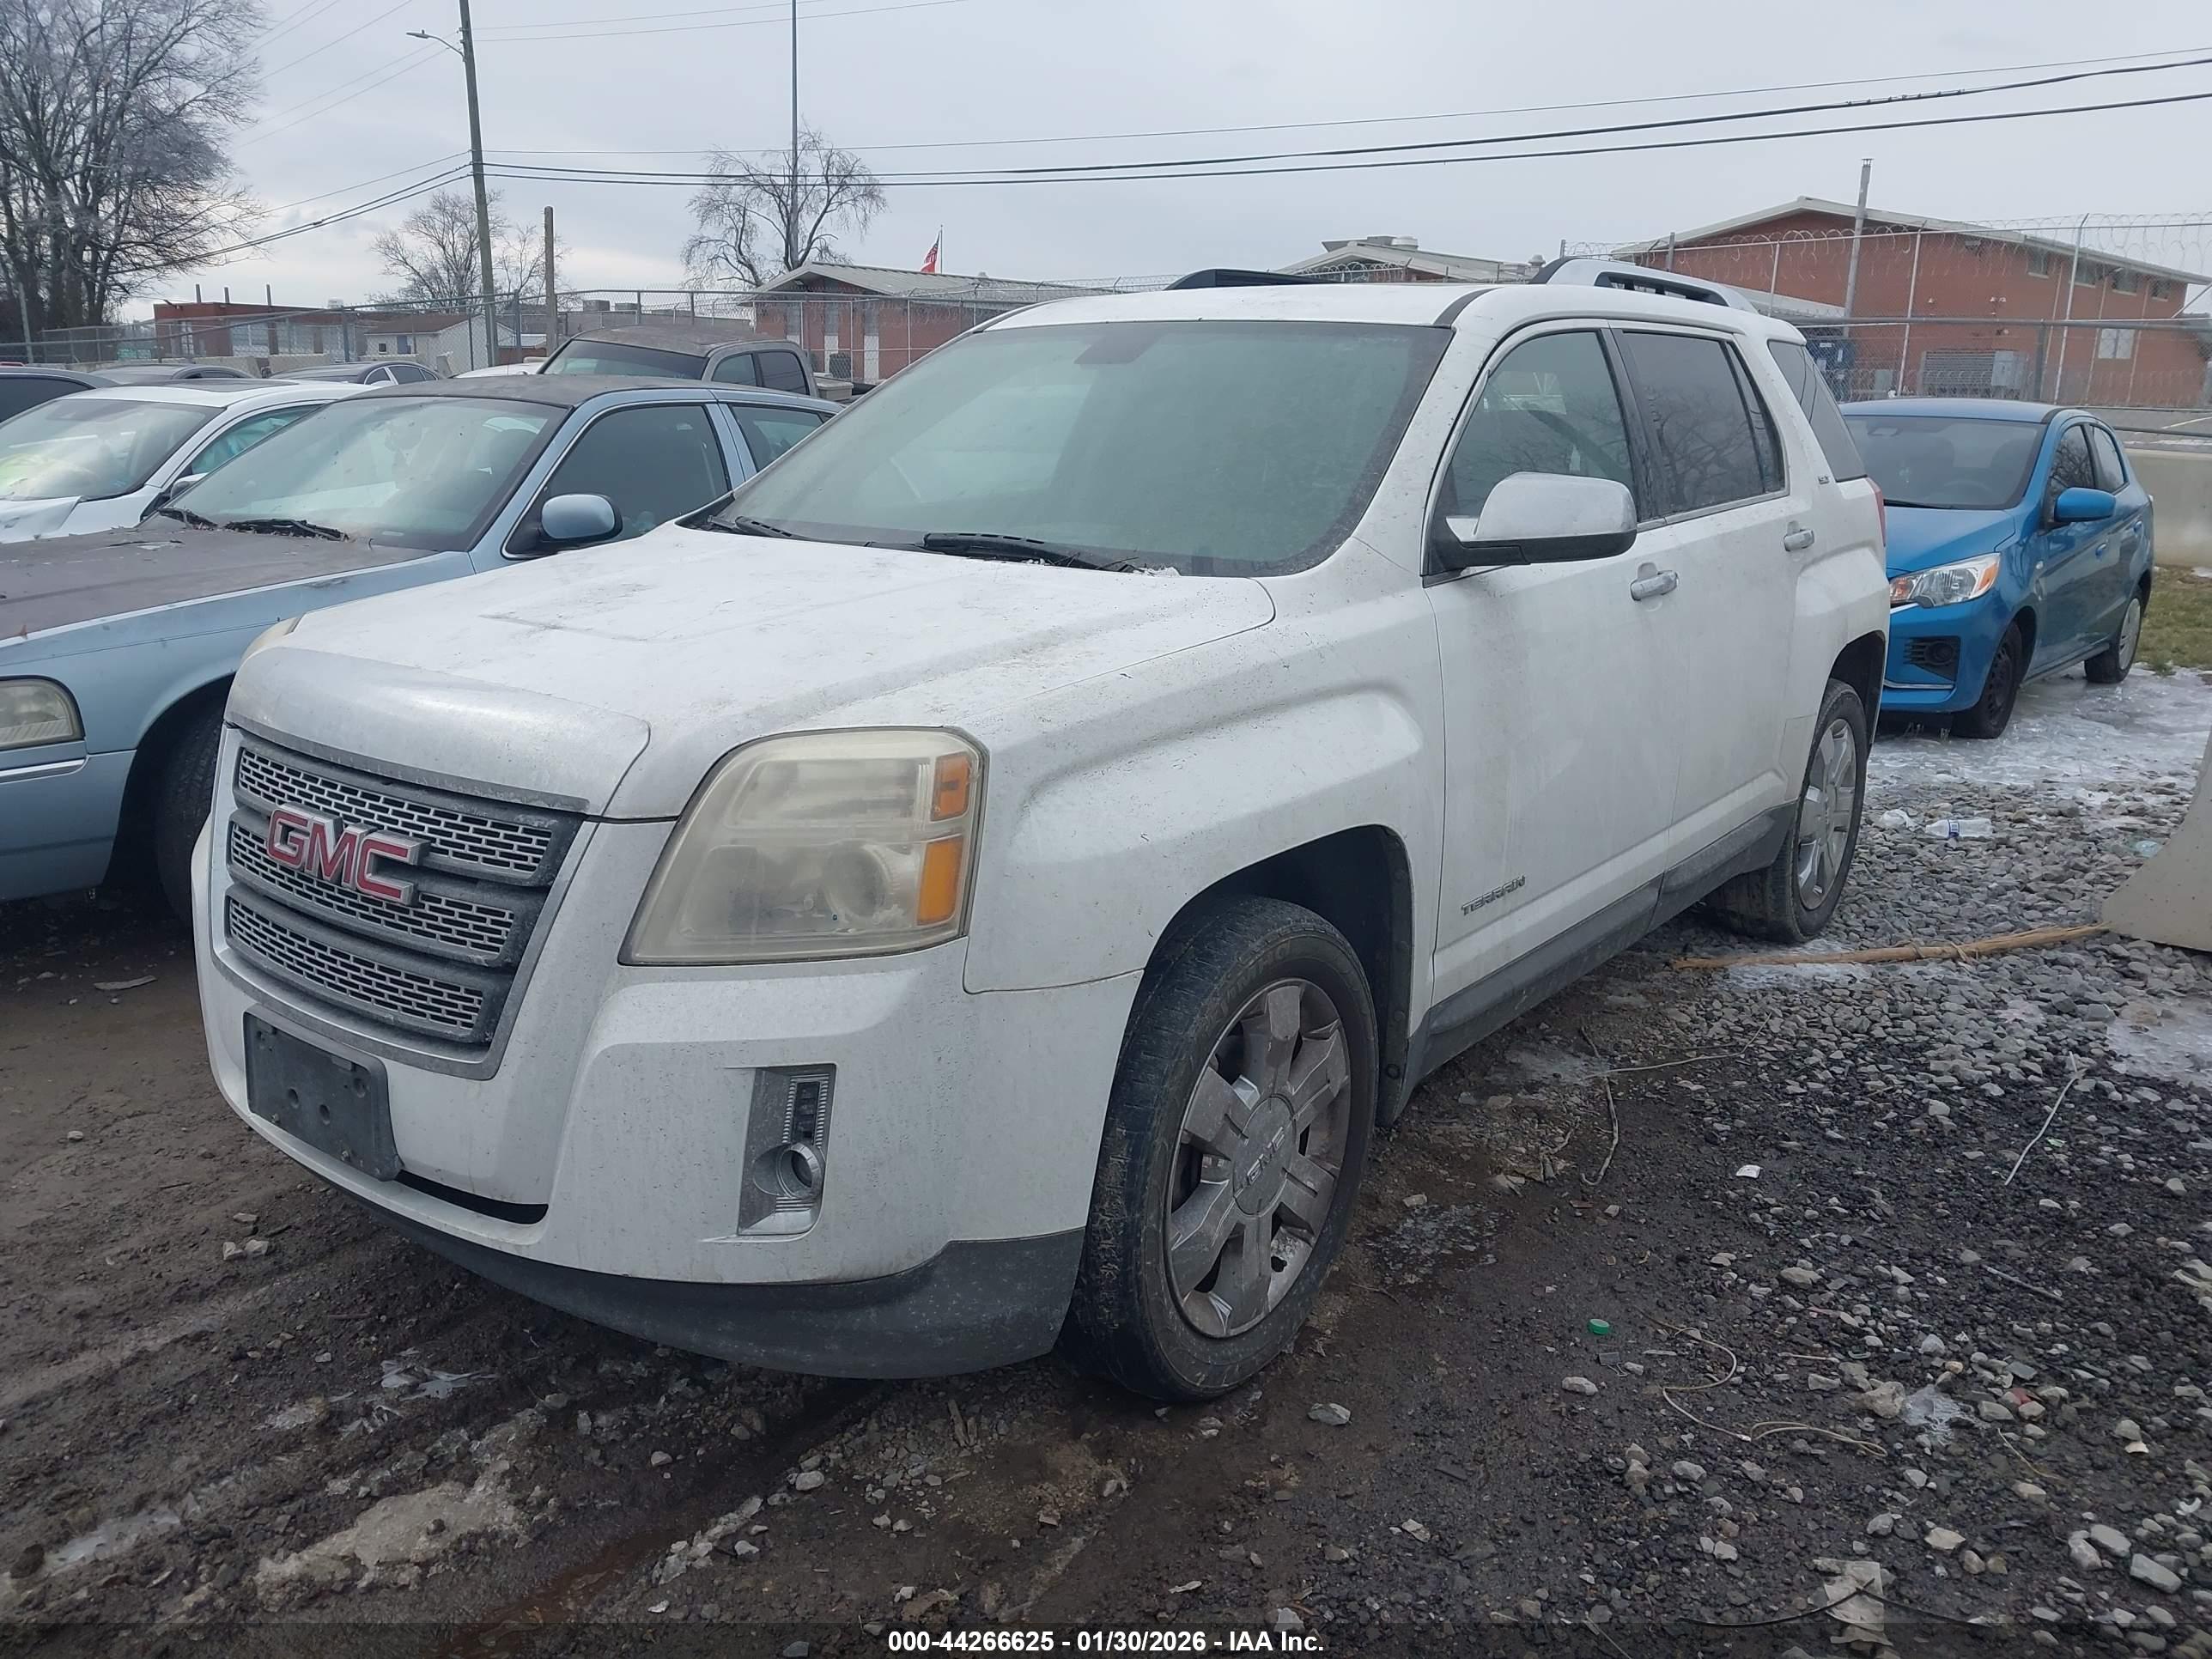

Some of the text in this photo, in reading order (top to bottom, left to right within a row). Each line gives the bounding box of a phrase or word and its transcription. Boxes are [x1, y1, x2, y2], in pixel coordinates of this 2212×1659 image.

[267, 803, 428, 905] GMC
[1461, 874, 1526, 916] TERRAIN
[1246, 1127, 1285, 1187] GMC
